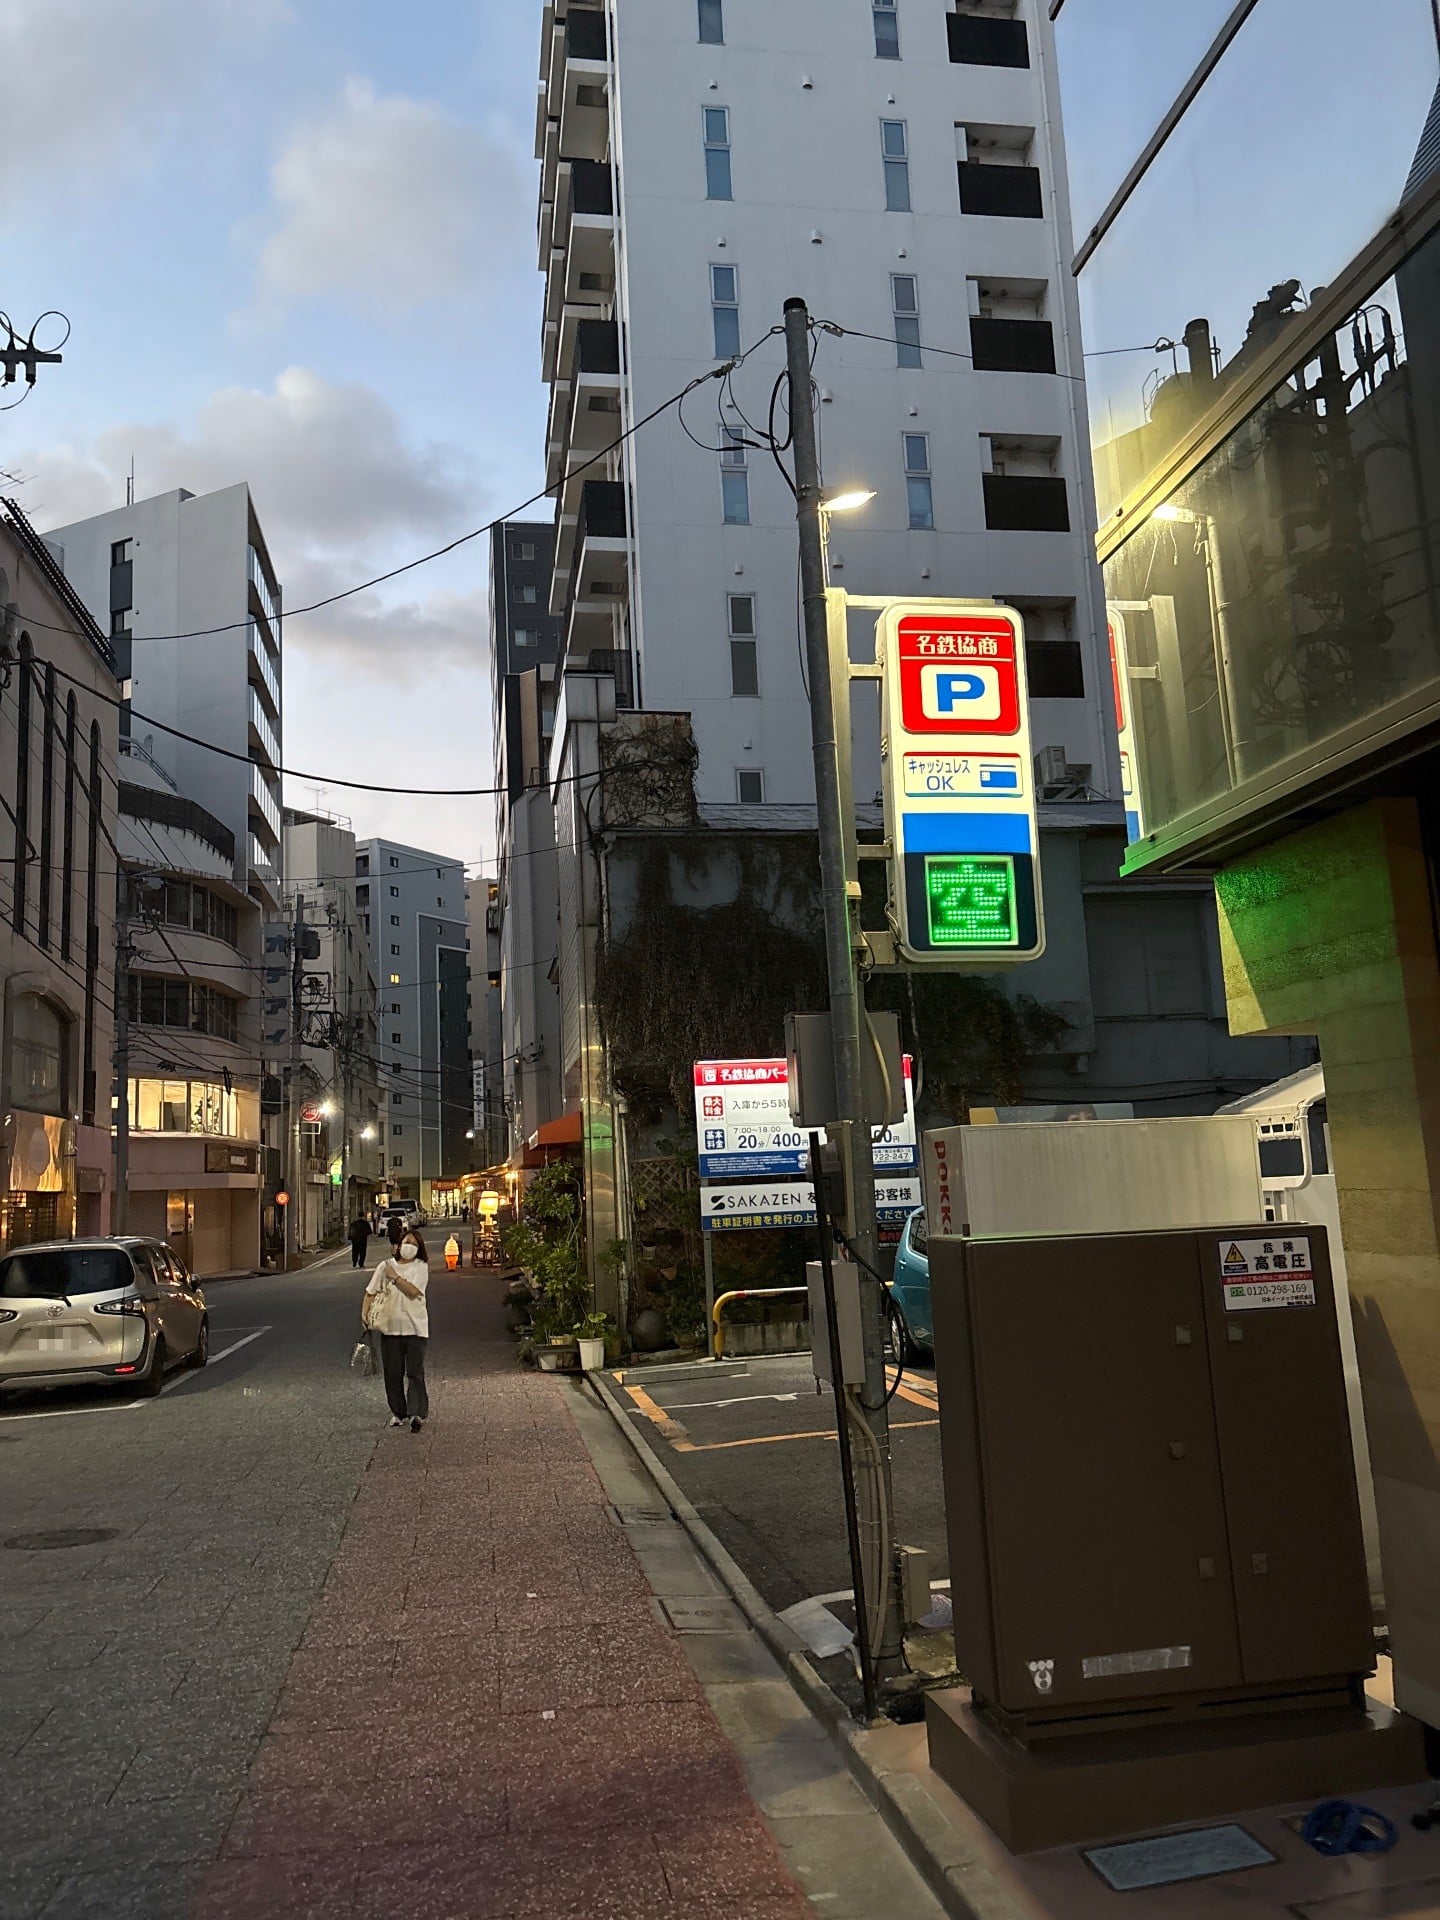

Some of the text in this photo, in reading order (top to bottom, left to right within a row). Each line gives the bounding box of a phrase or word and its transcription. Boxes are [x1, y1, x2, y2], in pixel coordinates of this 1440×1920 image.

[916, 635, 998, 656] 名鉄協商
[935, 673, 985, 712] P
[908, 759, 971, 774] キャッシュレス
[926, 775, 955, 791] OK
[728, 1193, 801, 1208] SAKAZEN
[1263, 1241, 1294, 1253] 危険
[1254, 1253, 1307, 1271] 高電圧
[1247, 1284, 1306, 1296] 0120-298-169
